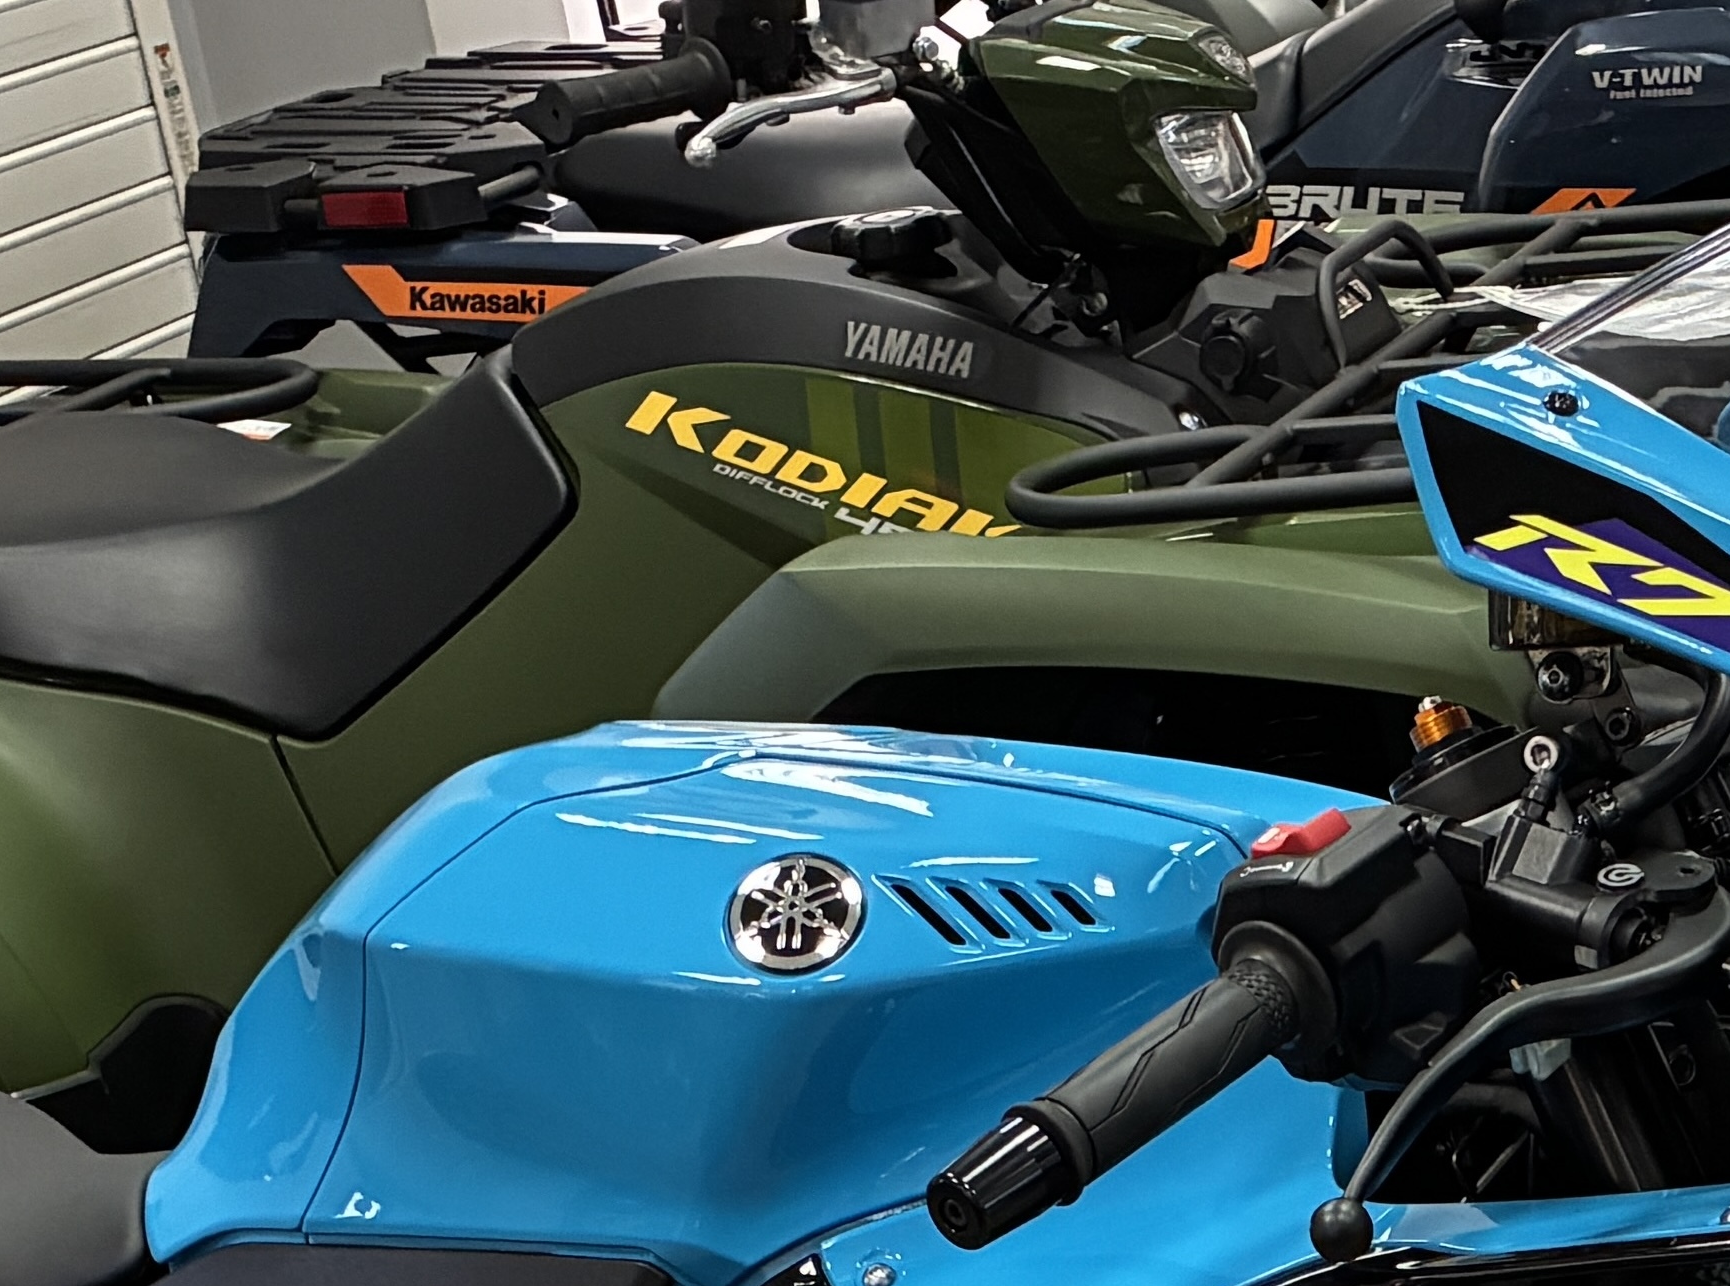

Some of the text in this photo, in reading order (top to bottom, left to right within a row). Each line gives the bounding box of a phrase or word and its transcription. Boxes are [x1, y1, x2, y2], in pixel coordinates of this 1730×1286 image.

[1592, 65, 1703, 88] V-TWIN
[1265, 184, 1465, 218] BRUTE
[409, 286, 547, 315] Kawasaki
[844, 320, 974, 379] YAMAHA
[712, 463, 830, 510] DIFFLOCK
